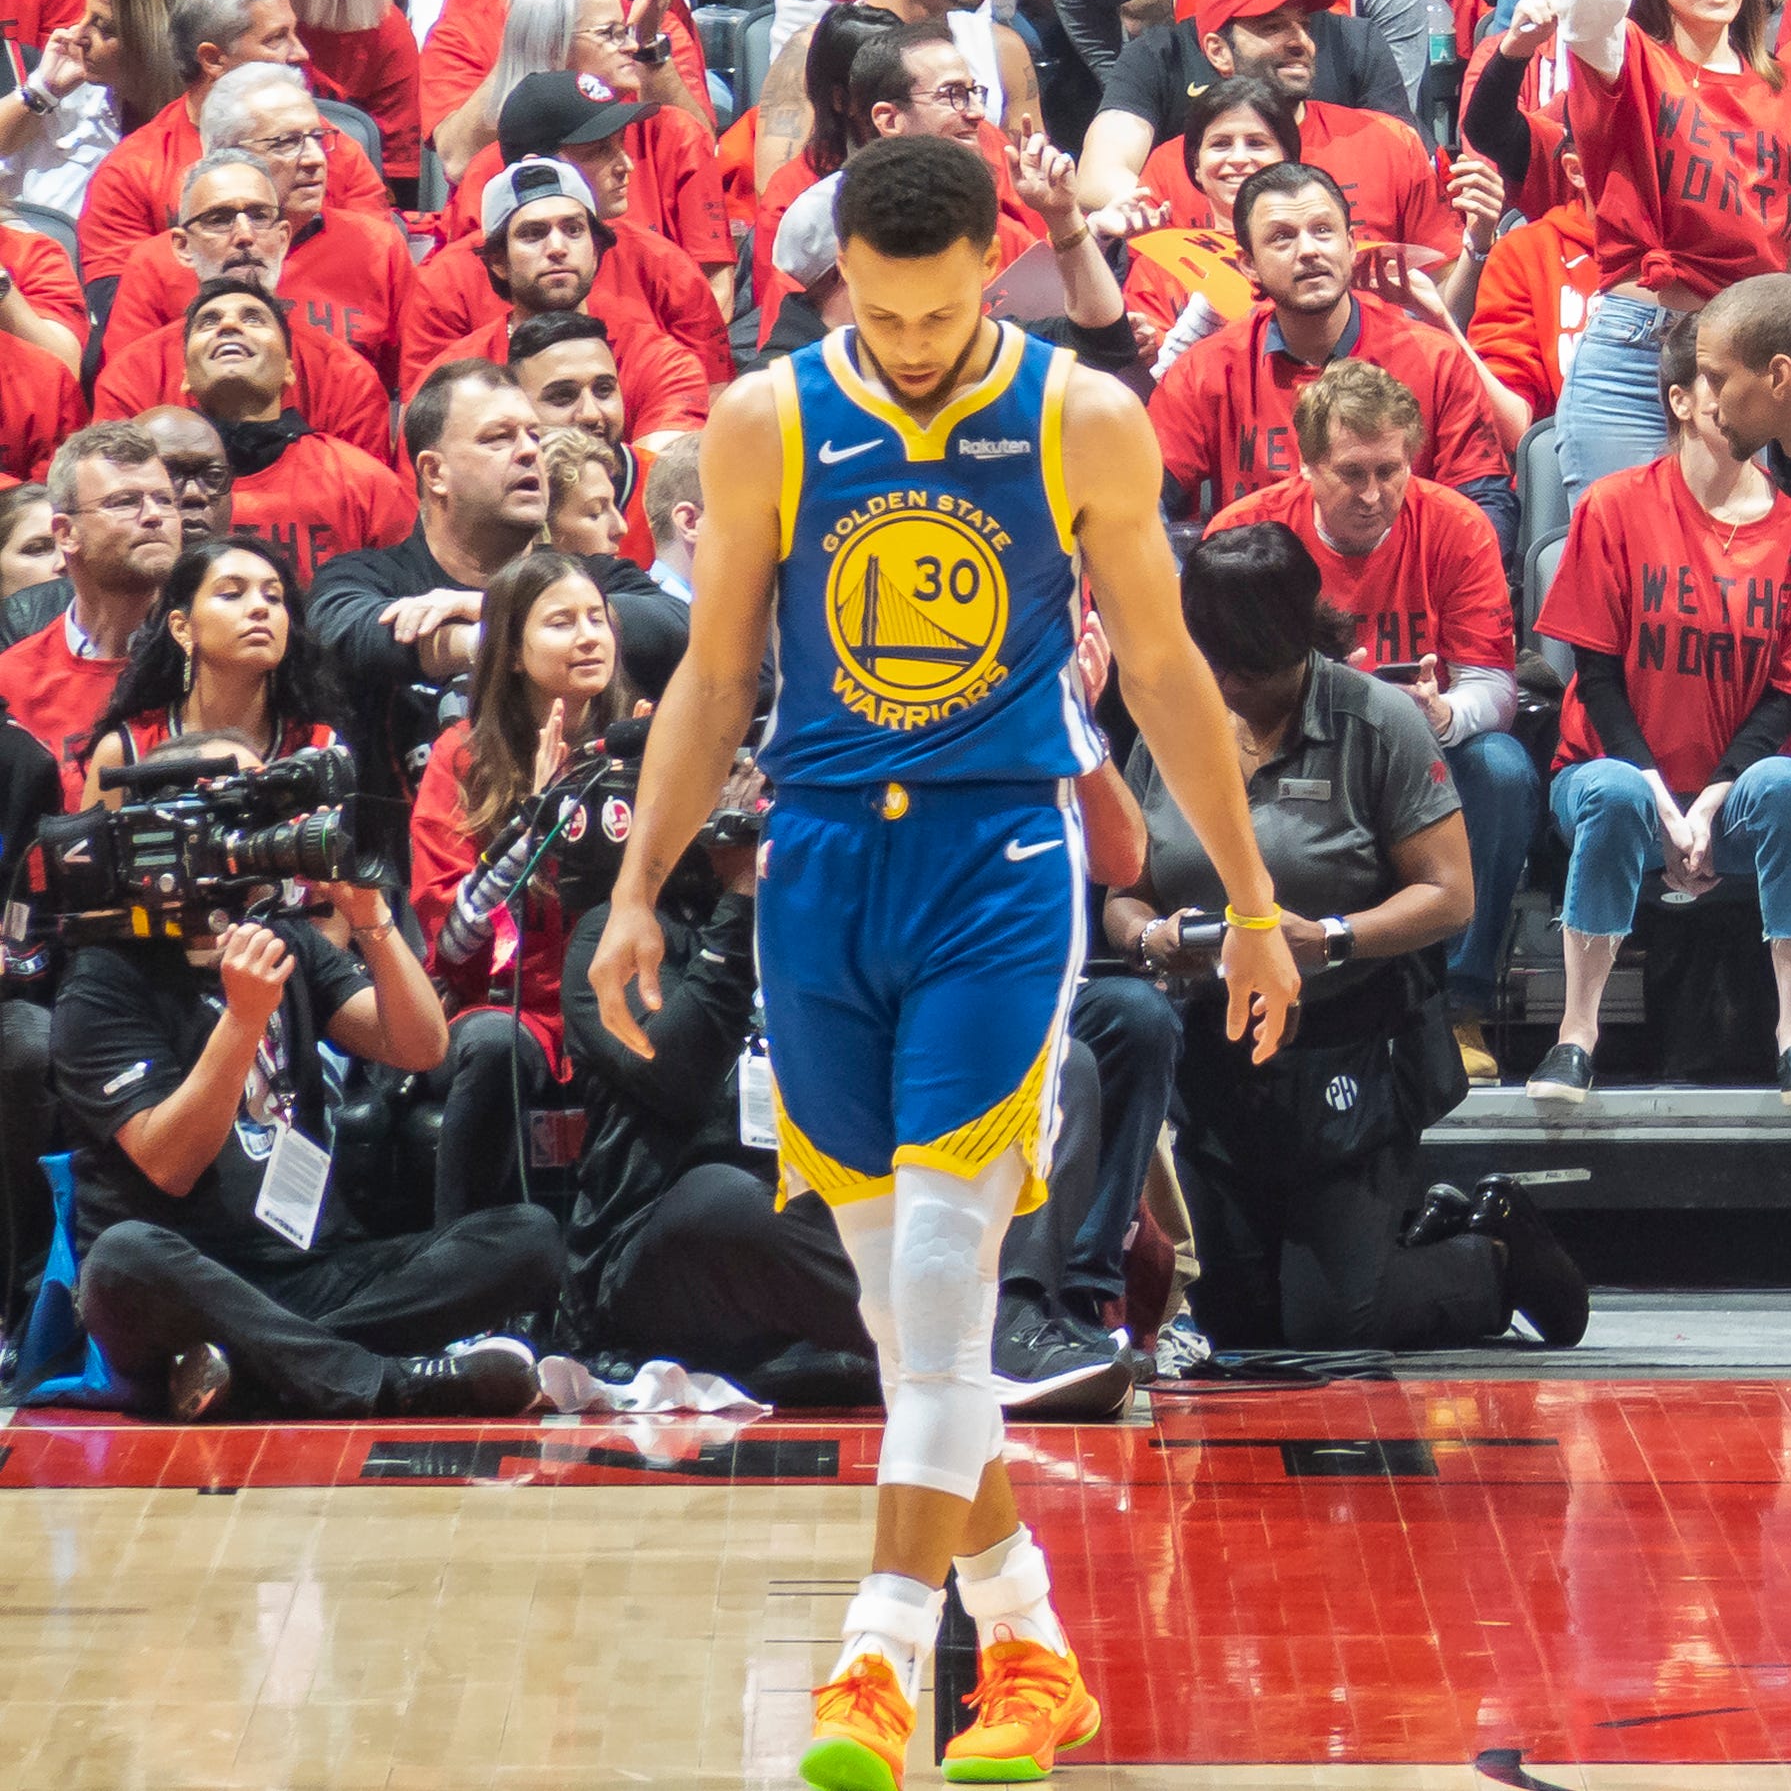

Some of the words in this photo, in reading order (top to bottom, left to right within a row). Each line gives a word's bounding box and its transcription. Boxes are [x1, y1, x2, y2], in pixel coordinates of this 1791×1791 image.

[1657, 90, 1713, 147] WE
[959, 438, 1031, 460] Rakuten
[1239, 423, 1291, 472] WE
[822, 489, 931, 554] GOLDEN
[934, 489, 1013, 554] STATE
[911, 554, 979, 607] 30
[1640, 564, 1698, 614] WE
[1639, 620, 1770, 688] NORT
[830, 659, 1010, 730] WARRIORS
